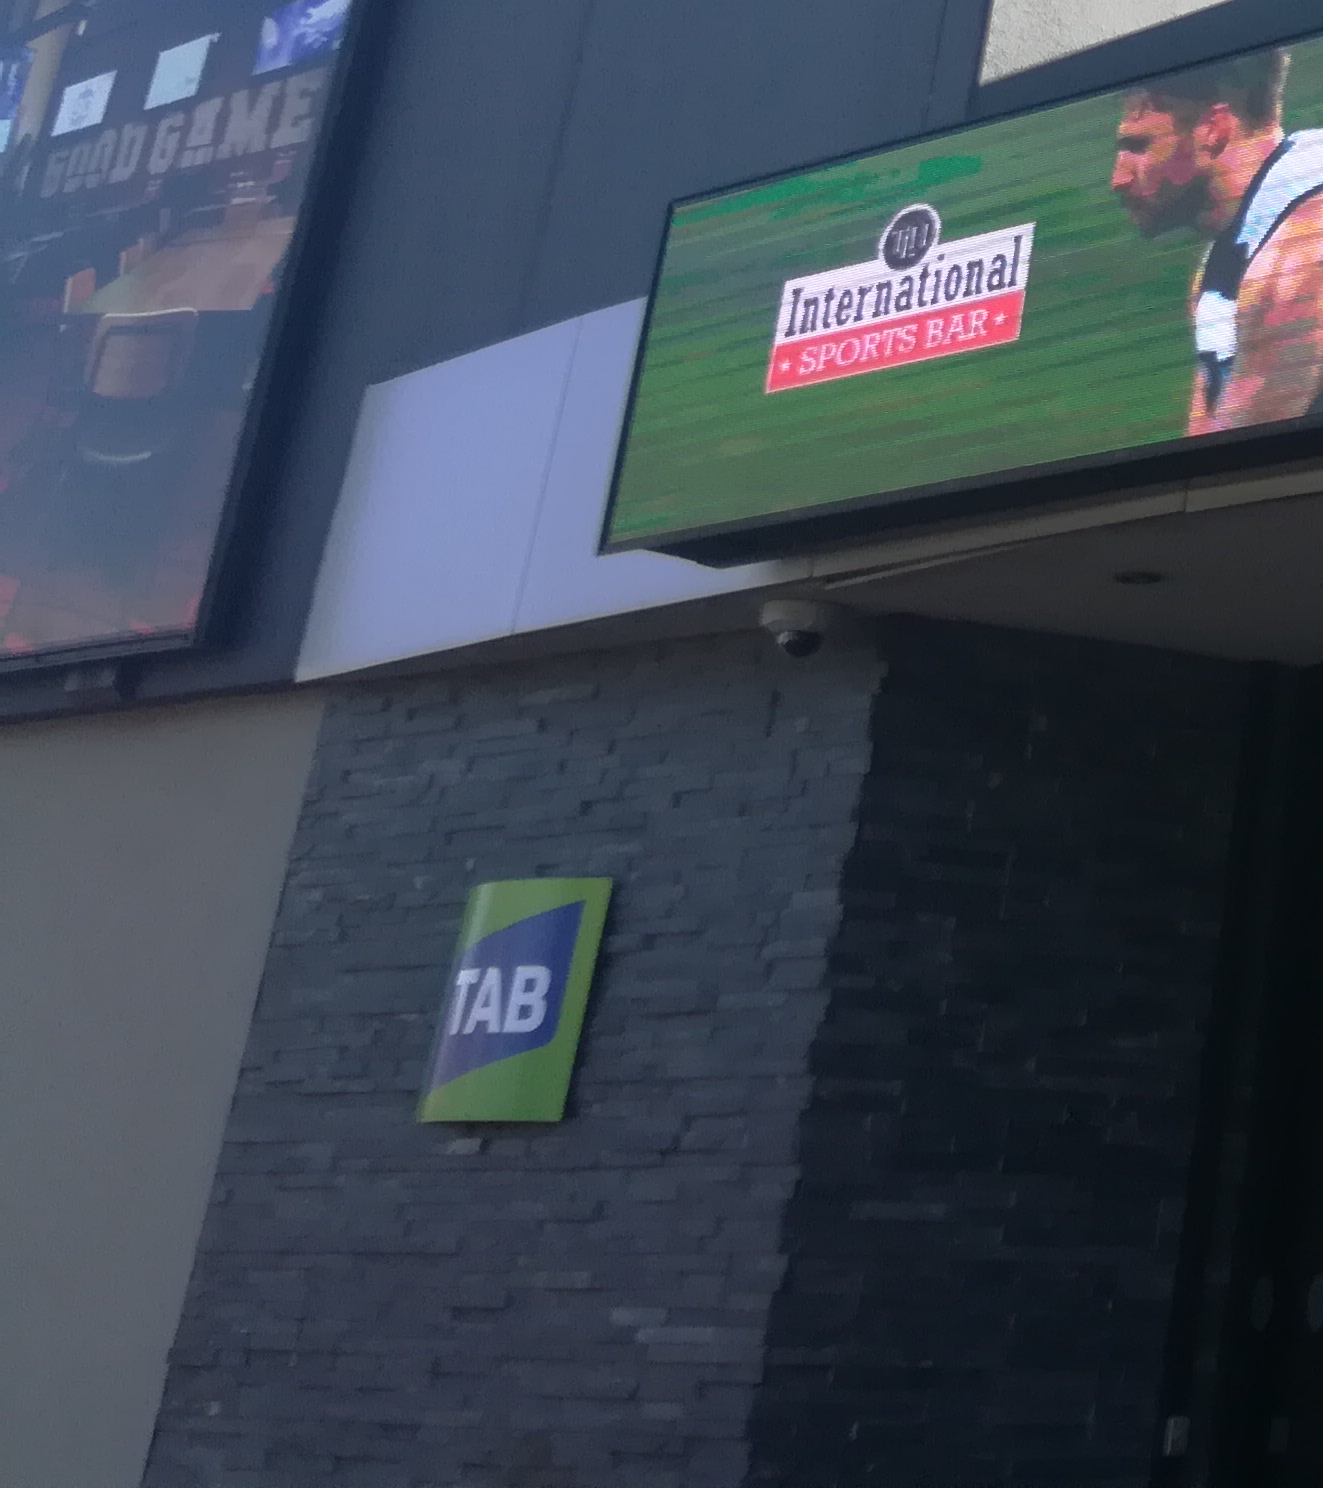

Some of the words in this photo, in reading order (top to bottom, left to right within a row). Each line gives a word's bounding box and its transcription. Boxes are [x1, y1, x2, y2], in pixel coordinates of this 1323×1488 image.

[784, 235, 1023, 337] International
[798, 324, 919, 375] SPORTS
[924, 308, 989, 348] BAR
[449, 965, 552, 1035] TAB
